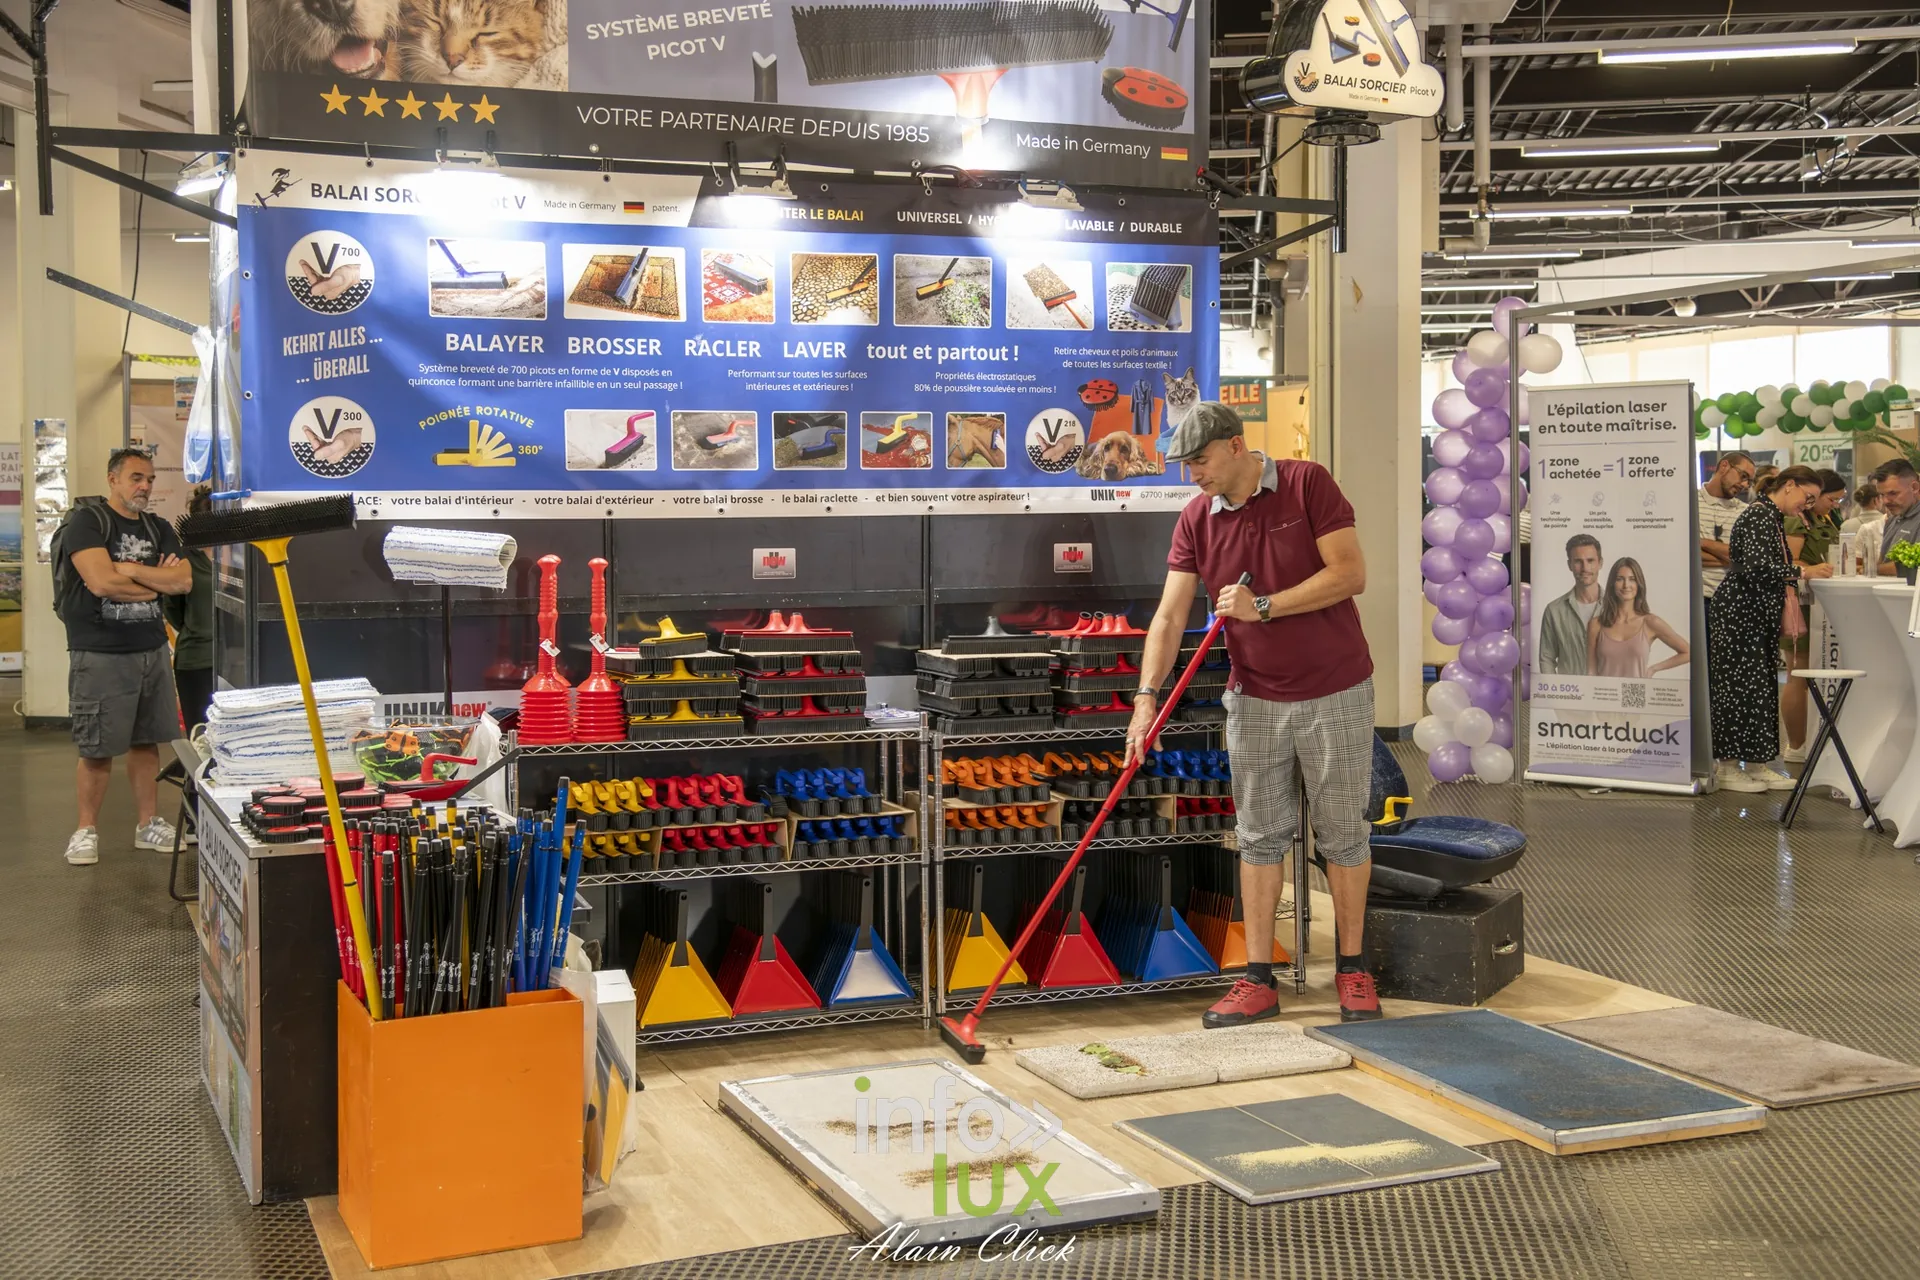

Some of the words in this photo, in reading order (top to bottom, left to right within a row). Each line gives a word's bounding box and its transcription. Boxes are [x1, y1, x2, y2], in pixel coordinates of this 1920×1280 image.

[585, 11, 681, 40] SYSTÈME
[683, 0, 773, 28] BREVETÉ
[646, 37, 705, 60] PICOT
[706, 35, 727, 53] V
[1323, 73, 1358, 88] BALAI
[1359, 75, 1407, 95] SORCIER
[1409, 86, 1430, 97] Picot
[1430, 88, 1437, 97] V
[576, 106, 653, 129] VOTRE
[659, 110, 795, 136] PARTENAIRE
[801, 118, 881, 141] DEPUIS
[886, 124, 930, 144] 1985
[1016, 133, 1061, 151] Made
[1064, 136, 1079, 152] in
[1082, 138, 1151, 160] Germany
[311, 182, 369, 202] BALAI
[543, 199, 567, 210] Made
[568, 200, 577, 210] in
[578, 202, 617, 213] Germany
[652, 203, 681, 214] patent.
[810, 208, 825, 221] LE
[827, 209, 864, 222] BALAI
[896, 211, 963, 225] UNIVERSEL
[1065, 219, 1115, 233] LAVABLE
[1129, 222, 1183, 234] DURABLE
[340, 246, 361, 258] 700
[282, 331, 327, 357] KEHRT
[328, 325, 367, 350] ALLES
[445, 333, 545, 354] BALAYER
[567, 336, 663, 356] BROSSER
[684, 338, 762, 358] RACLER
[783, 341, 847, 358] LAVER
[866, 343, 907, 360] tout
[912, 345, 933, 360] et
[937, 344, 1009, 365] partout
[1053, 346, 1077, 357] Retire
[1078, 347, 1110, 357] cheveux
[1111, 348, 1120, 357] et
[1120, 348, 1140, 359] poils
[1141, 347, 1179, 358] d'animaux
[313, 354, 371, 381] ÜBERALL
[419, 363, 458, 375] Système
[460, 363, 495, 375] breveté
[497, 364, 510, 374] de
[511, 365, 528, 375] 700
[529, 364, 556, 378] picots
[557, 369, 570, 377] en
[571, 366, 597, 377] forme
[597, 367, 612, 377] de
[613, 367, 620, 377] V
[621, 366, 657, 380] disposés
[657, 368, 673, 377] en
[1062, 359, 1073, 369] de
[1074, 360, 1099, 369] toutes
[1100, 360, 1111, 369] les
[1112, 360, 1143, 370] surfaces
[1145, 361, 1168, 370] textile
[728, 369, 775, 380] Performant
[776, 371, 791, 379] sur
[793, 370, 820, 379] toutes
[821, 369, 833, 379] les
[834, 370, 868, 380] surfaces
[935, 371, 975, 383] Propriétés
[976, 372, 1036, 384] électrostatiques
[408, 377, 456, 389] quinconce
[458, 377, 496, 388] formant
[497, 380, 515, 388] une
[516, 377, 553, 388] barrière
[554, 378, 596, 389] infaillible
[596, 381, 608, 389] en
[610, 381, 622, 389] un
[623, 380, 642, 389] seul
[643, 381, 678, 392] passage
[745, 380, 792, 391] intérieures
[793, 382, 802, 391] et
[803, 381, 849, 392] extérieures
[914, 383, 932, 393] 80%
[932, 383, 942, 393] de
[943, 383, 982, 396] poussière
[982, 383, 1017, 394] soulevée
[1018, 386, 1028, 394] en
[1029, 385, 1053, 394] moins
[343, 411, 362, 422] 300
[1547, 402, 1625, 419] L'épilation
[1628, 400, 1668, 413] laser
[418, 405, 471, 431] POIGNÉE
[476, 406, 536, 429] ROTATIVE
[1063, 420, 1077, 429] 218
[1538, 424, 1557, 435] en
[1559, 421, 1603, 434] toute
[1605, 418, 1677, 432] maîtrise.
[517, 445, 544, 456] 360°
[1550, 457, 1580, 467] zone
[1628, 456, 1660, 465] zone
[1549, 466, 1601, 479] achetée
[391, 498, 422, 506] votre
[424, 495, 454, 506] balai
[455, 495, 514, 506] d'intérieur
[534, 497, 565, 505] votre
[566, 495, 594, 505] balai
[595, 495, 655, 506] d'extérieur
[673, 496, 701, 505] votre
[703, 494, 728, 505] balai
[730, 494, 764, 505] brosse
[782, 494, 792, 503] le
[794, 494, 818, 504] balai
[820, 494, 858, 504] raclette
[875, 494, 886, 503] et
[887, 493, 909, 503] bien
[911, 494, 949, 503] souvent
[951, 494, 974, 503] votre
[977, 493, 1025, 505] aspirateur
[1091, 489, 1116, 501] UNIK
[1116, 490, 1131, 498] new
[1140, 491, 1163, 499] 67700
[1164, 491, 1191, 500] Haegen
[1538, 683, 1549, 691] 30
[1559, 684, 1580, 693] 50%
[1537, 721, 1680, 746] smartduck
[1546, 743, 1582, 751] L'épilation
[1616, 747, 1642, 756] portée
[1643, 748, 1653, 756] de
[1654, 749, 1670, 757] tous
